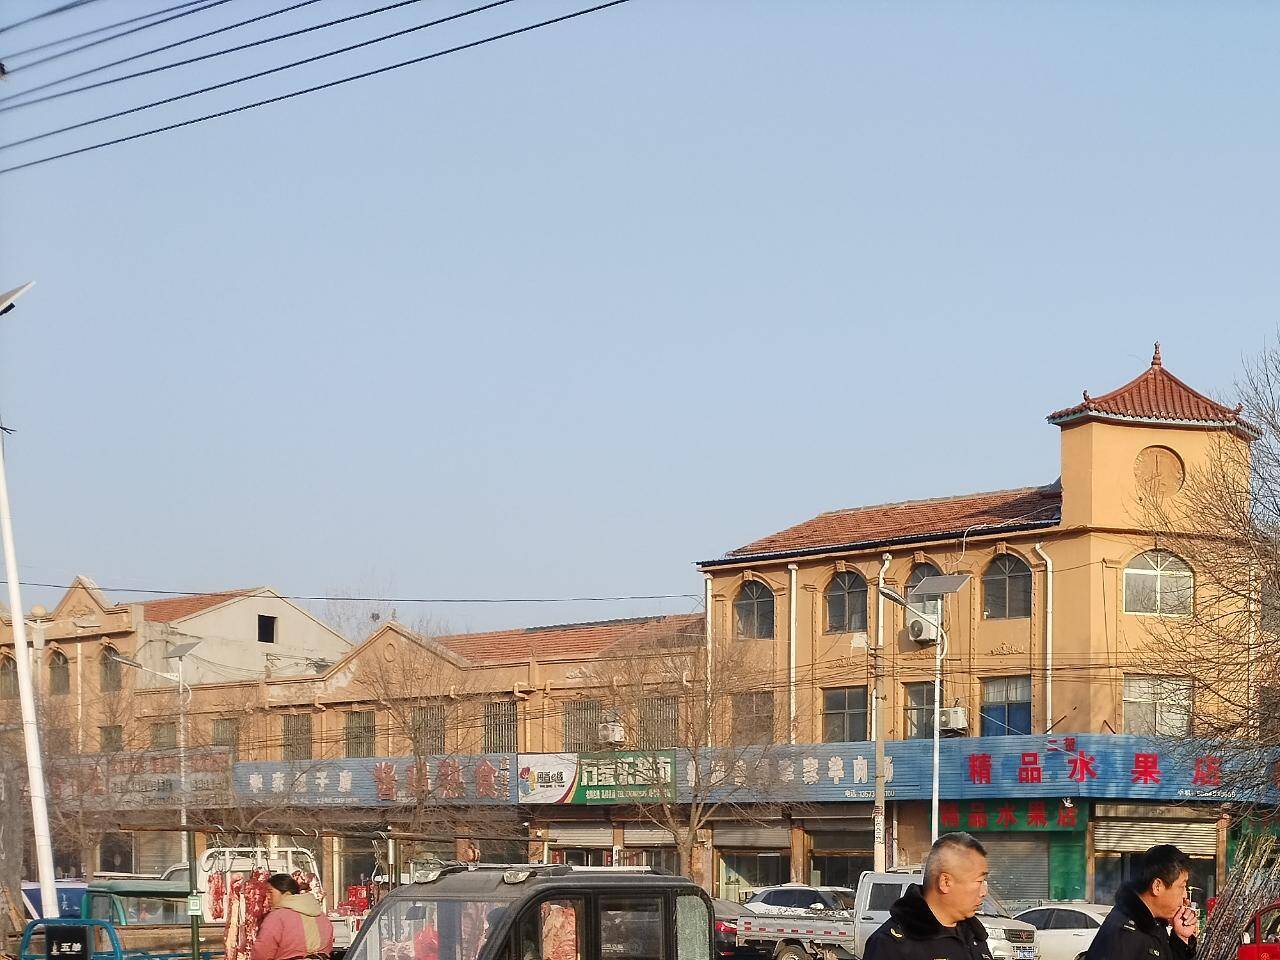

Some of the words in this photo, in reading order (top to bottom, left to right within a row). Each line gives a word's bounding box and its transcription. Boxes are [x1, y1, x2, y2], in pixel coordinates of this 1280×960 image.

[968, 750, 1222, 786] 精品水果店
